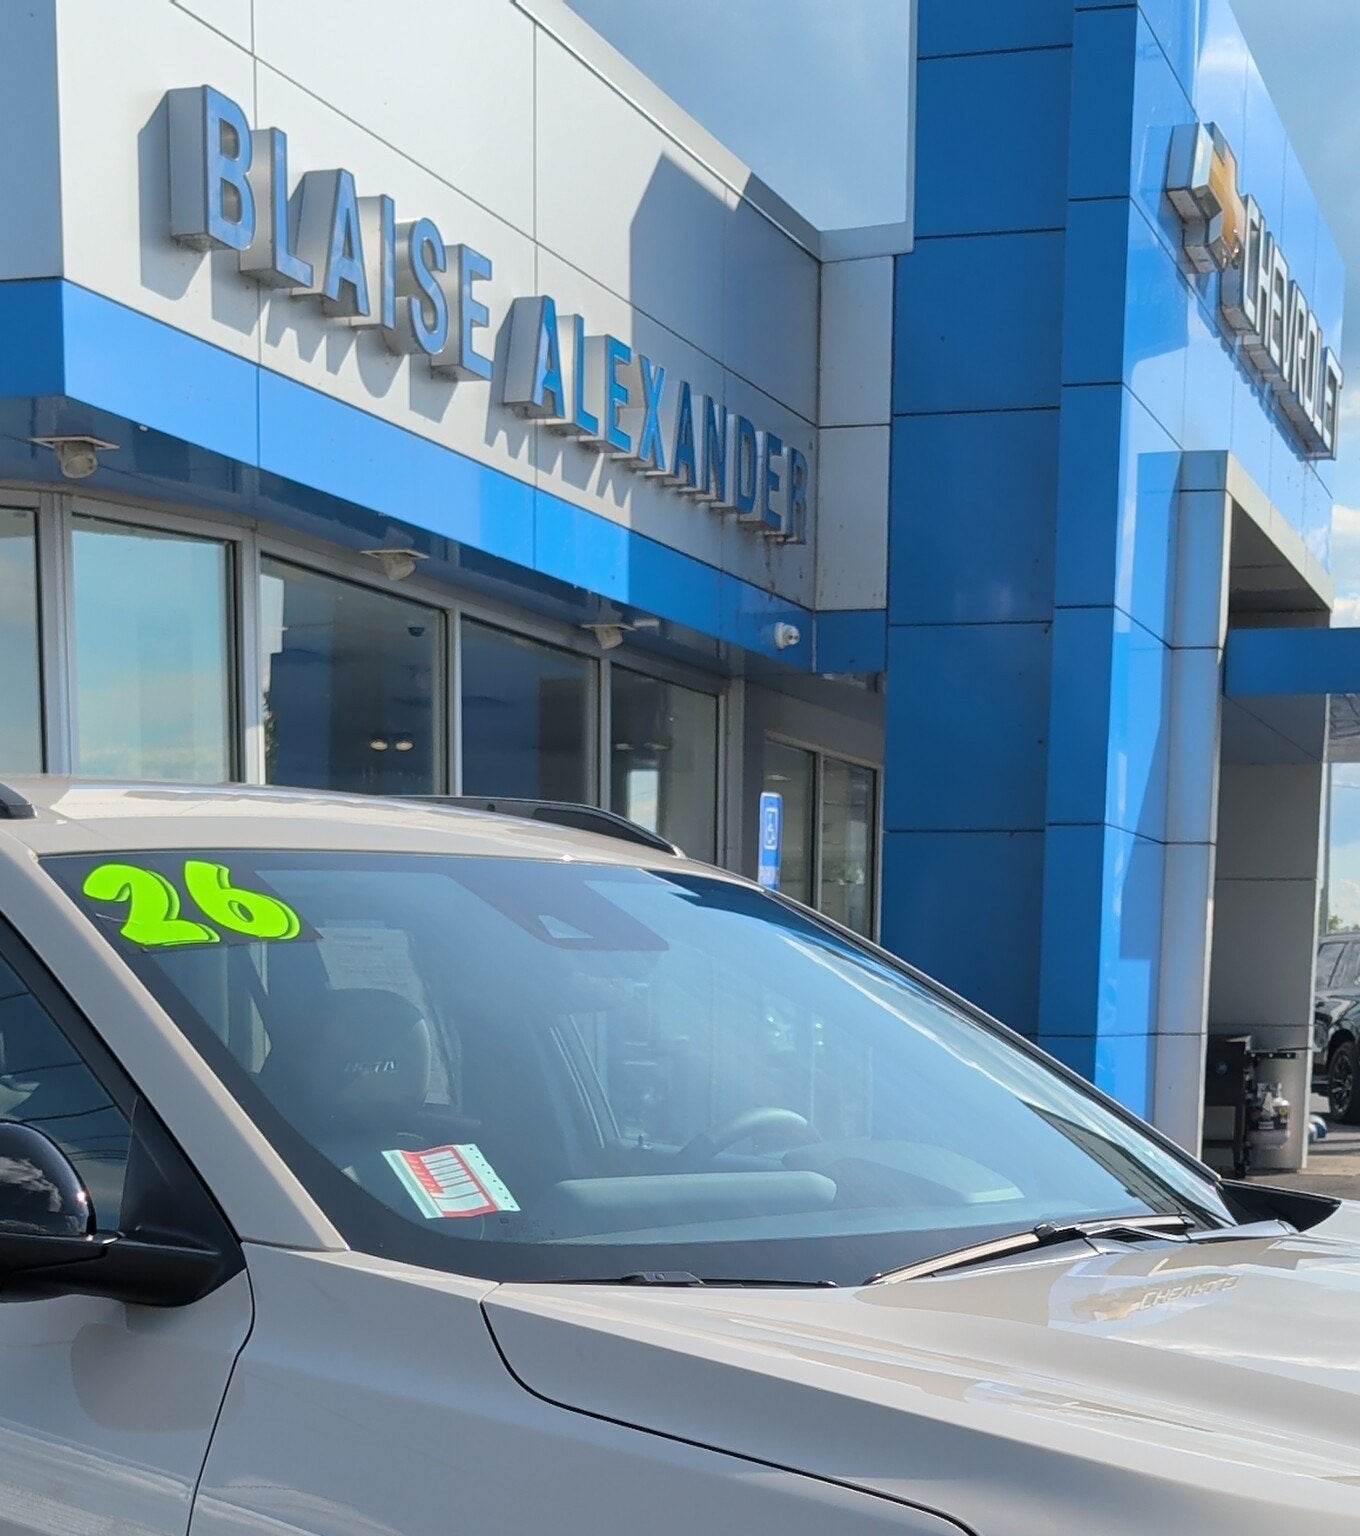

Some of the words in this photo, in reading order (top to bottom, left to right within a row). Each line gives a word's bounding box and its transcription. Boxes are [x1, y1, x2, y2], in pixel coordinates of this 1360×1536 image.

[170, 84, 495, 382] BLAISE
[503, 294, 808, 546] ALEXANDER
[1238, 193, 1344, 460] CHEVROLET
[83, 860, 300, 946] 26
